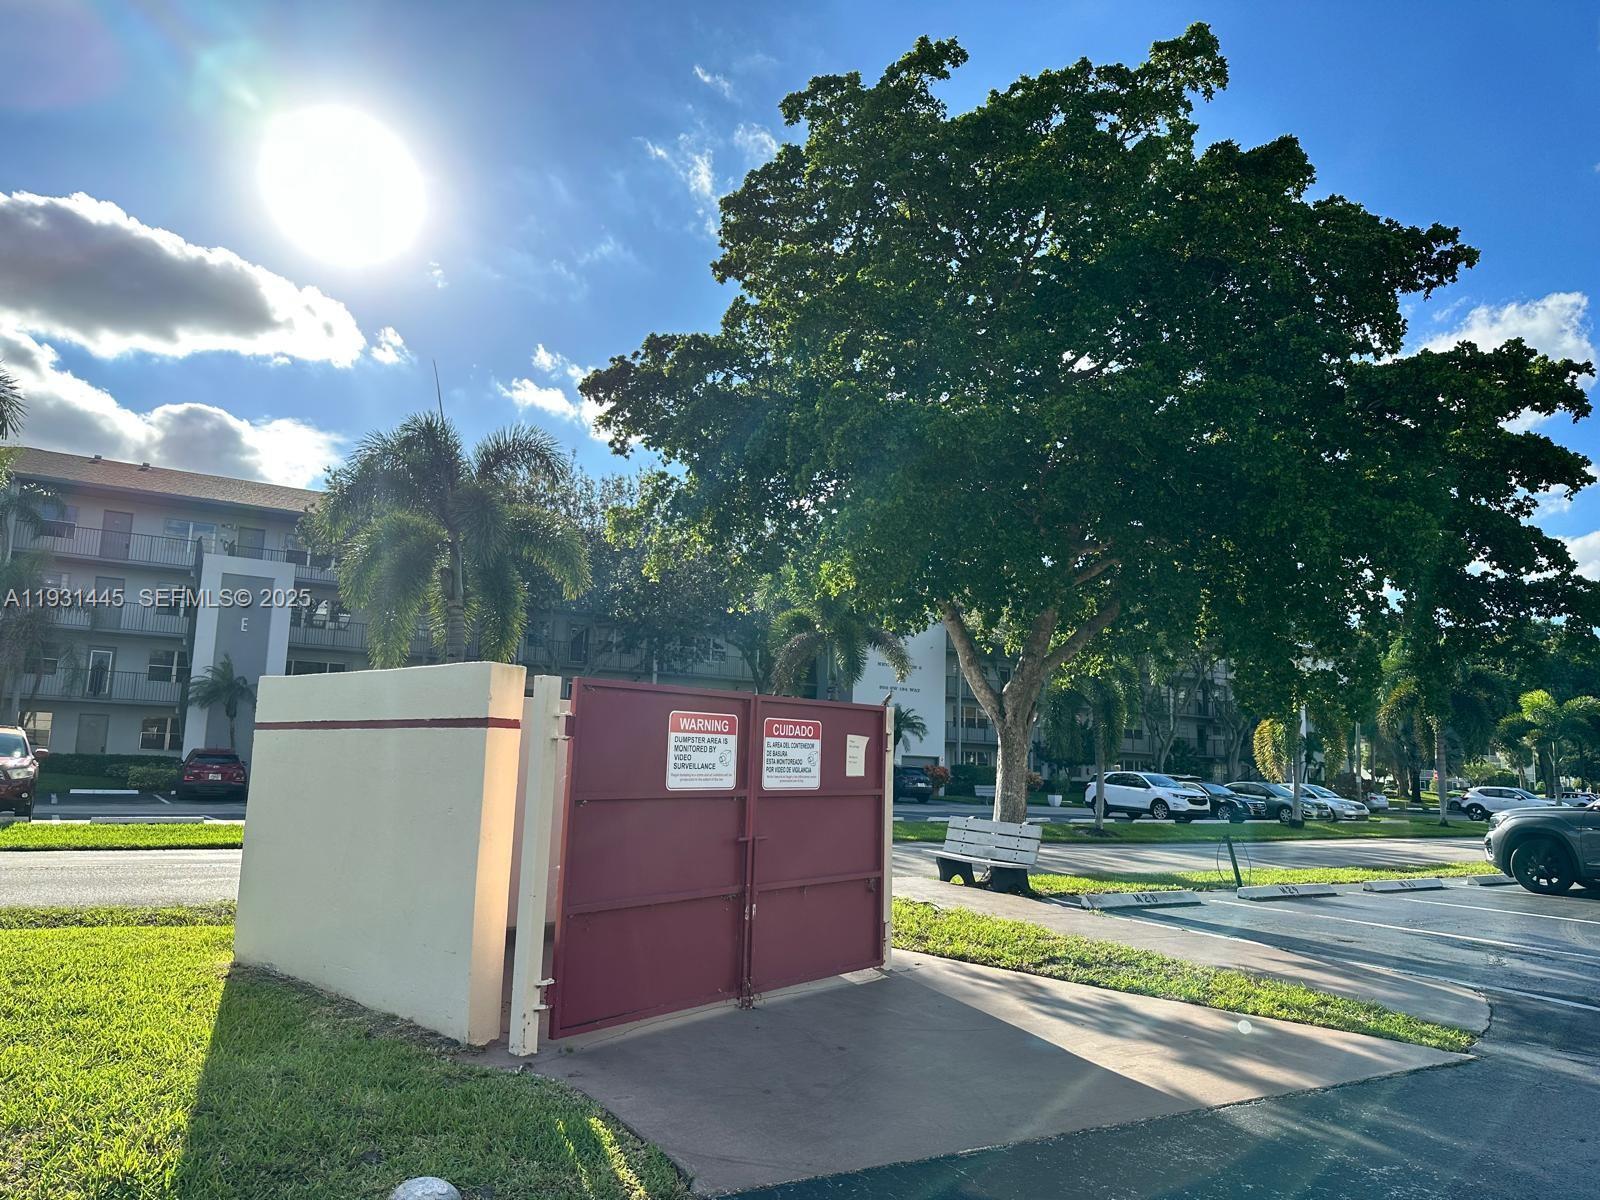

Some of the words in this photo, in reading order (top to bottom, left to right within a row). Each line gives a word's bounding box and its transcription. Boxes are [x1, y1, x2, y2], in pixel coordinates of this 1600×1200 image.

[240, 617, 249, 632] E
[679, 717, 729, 732] WARNING
[772, 724, 814, 737] CUIDADO
[674, 736, 706, 744] DUMPSTER
[674, 744, 708, 752] MONITORED
[673, 762, 716, 770] SURVEILLANCE
[1278, 886, 1299, 895] M29
